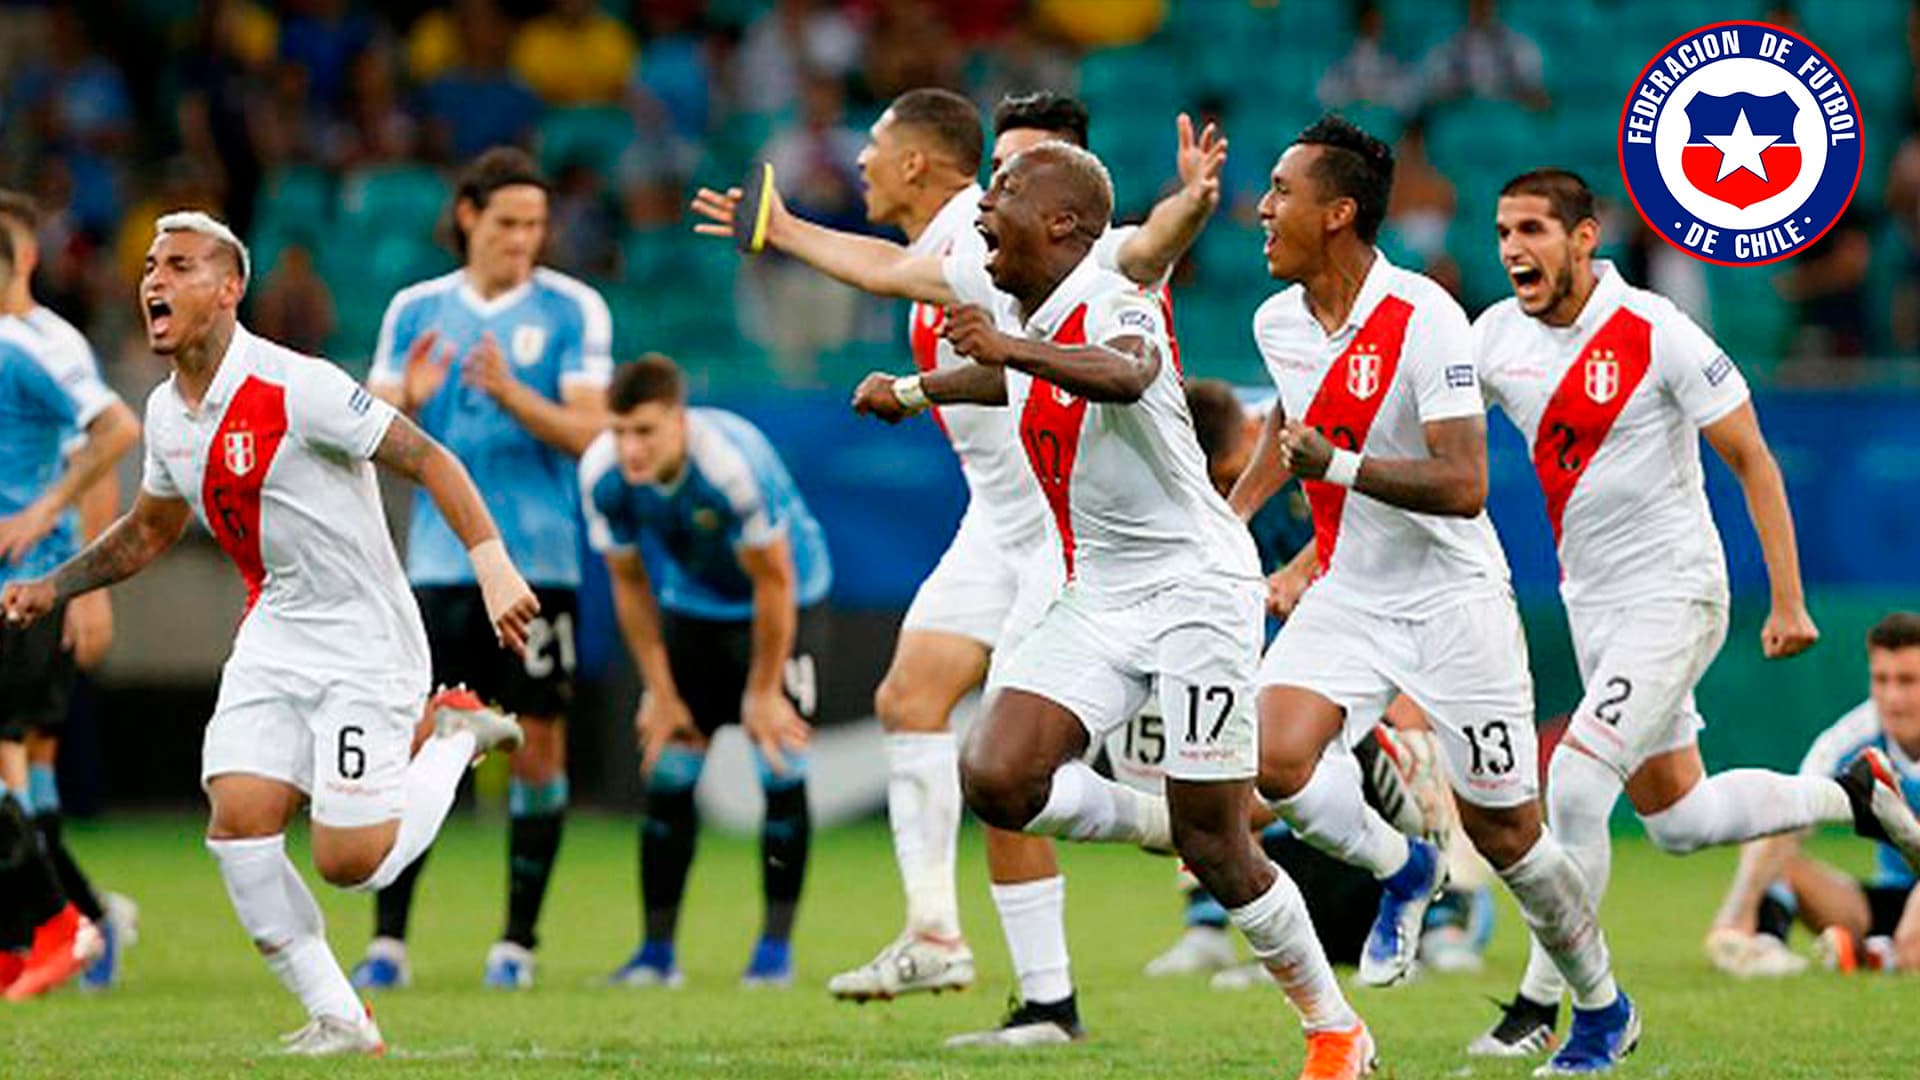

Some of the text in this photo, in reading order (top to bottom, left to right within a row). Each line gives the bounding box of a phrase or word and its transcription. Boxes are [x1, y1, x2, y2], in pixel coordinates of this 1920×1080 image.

[1185, 684, 1235, 744] 17
[1594, 675, 1632, 727] 2
[337, 725, 366, 779] 6
[1125, 714, 1166, 765] 15
[1462, 720, 1515, 775] 13
